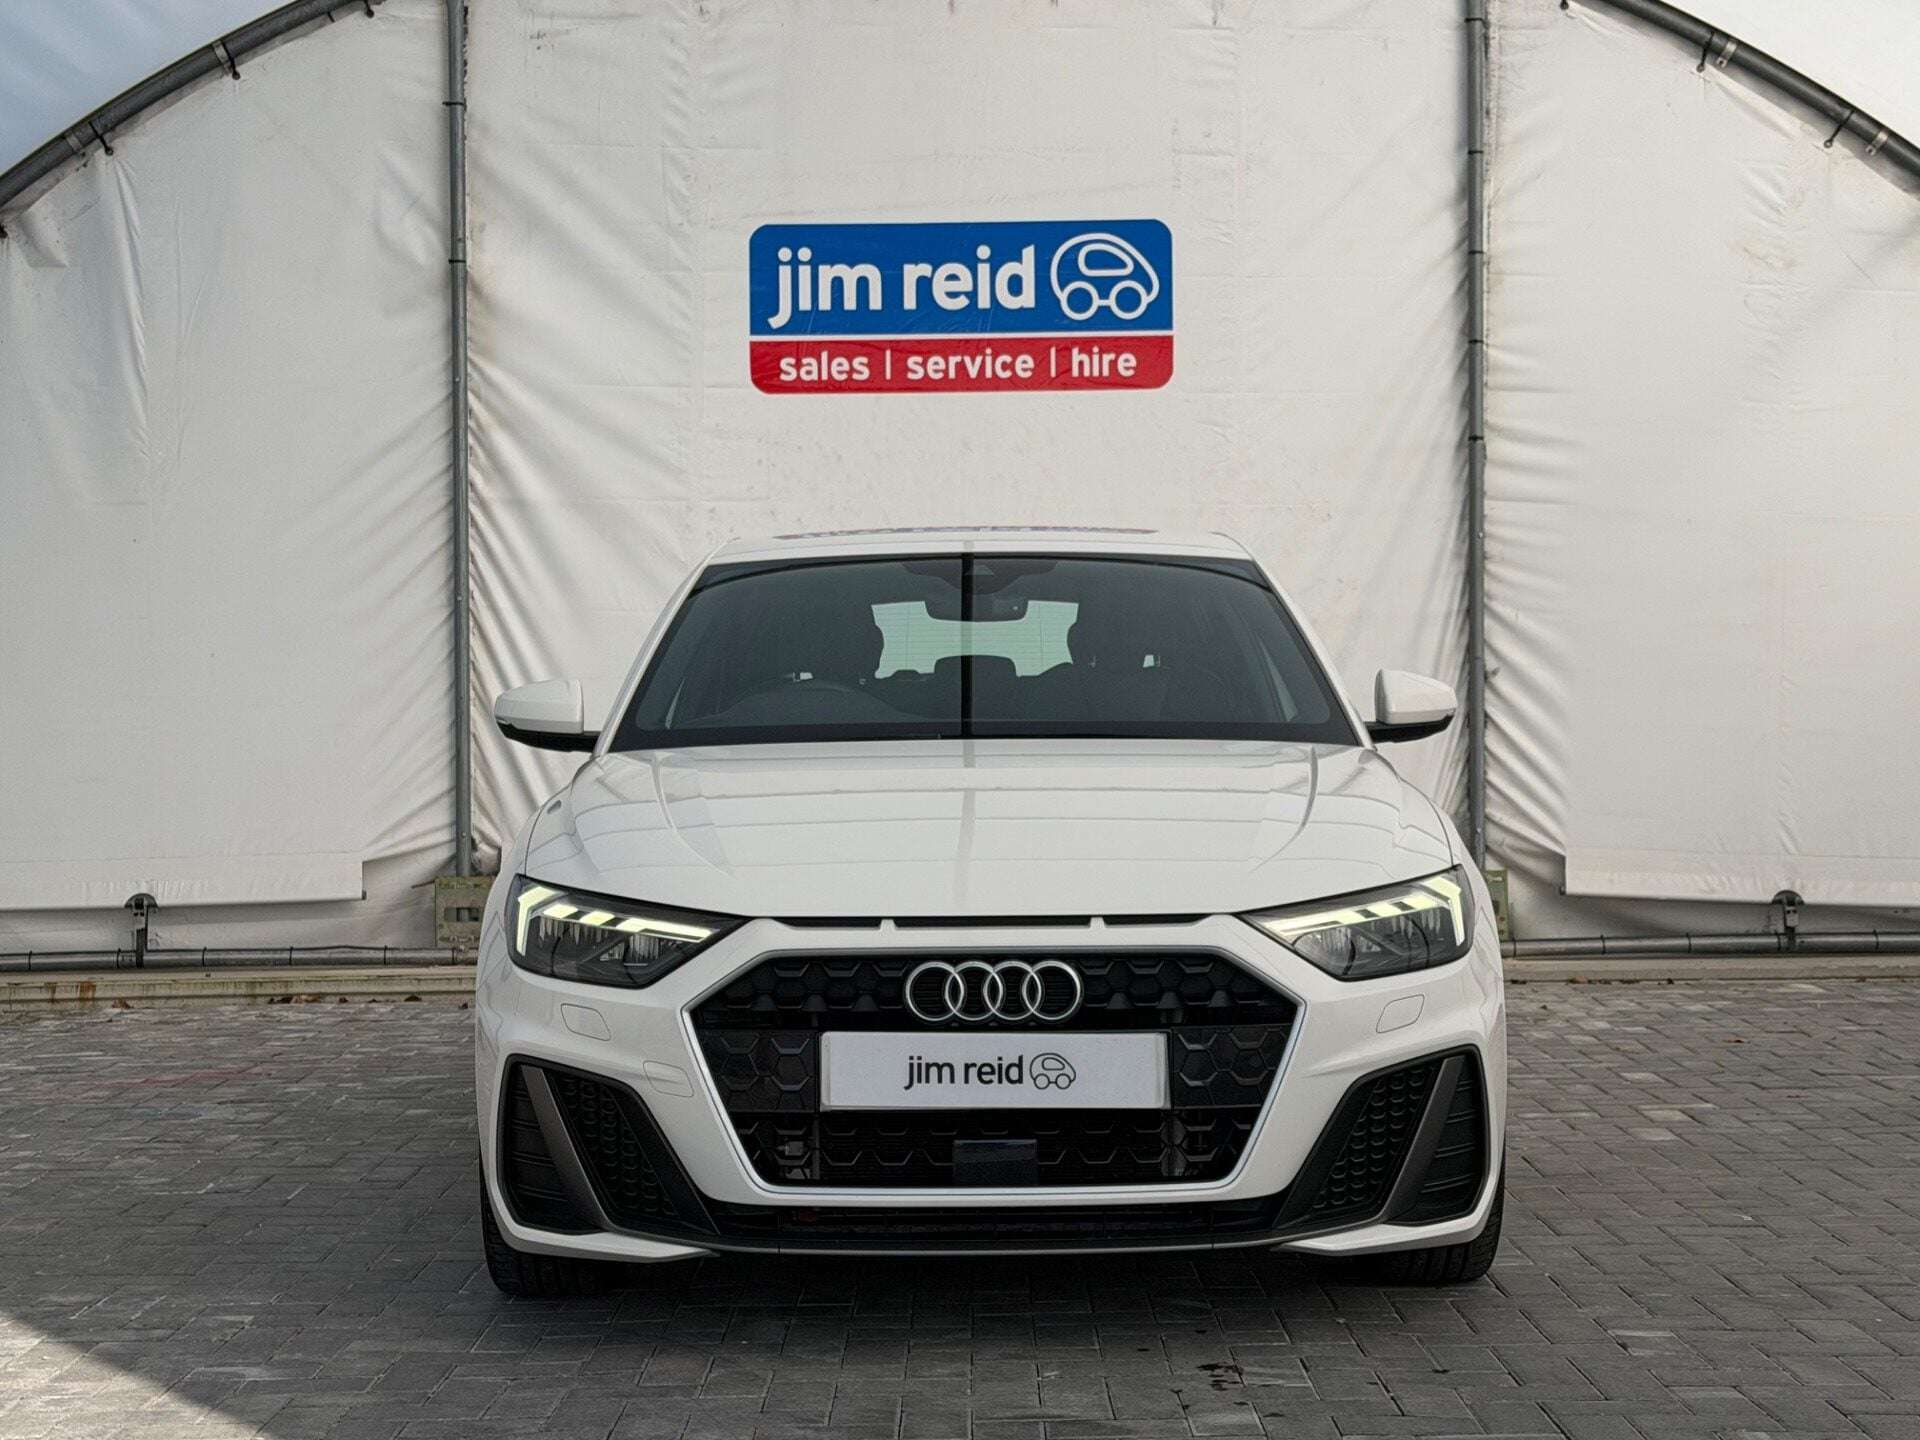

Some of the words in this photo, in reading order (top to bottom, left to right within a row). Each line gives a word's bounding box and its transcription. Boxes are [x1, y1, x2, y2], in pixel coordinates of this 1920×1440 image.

[767, 247, 882, 329] jim
[903, 244, 1036, 311] reid
[779, 350, 871, 382] sales
[906, 347, 1035, 380] service
[1071, 345, 1137, 378] hire
[903, 1056, 955, 1091] jim
[964, 1055, 1024, 1085] reid
